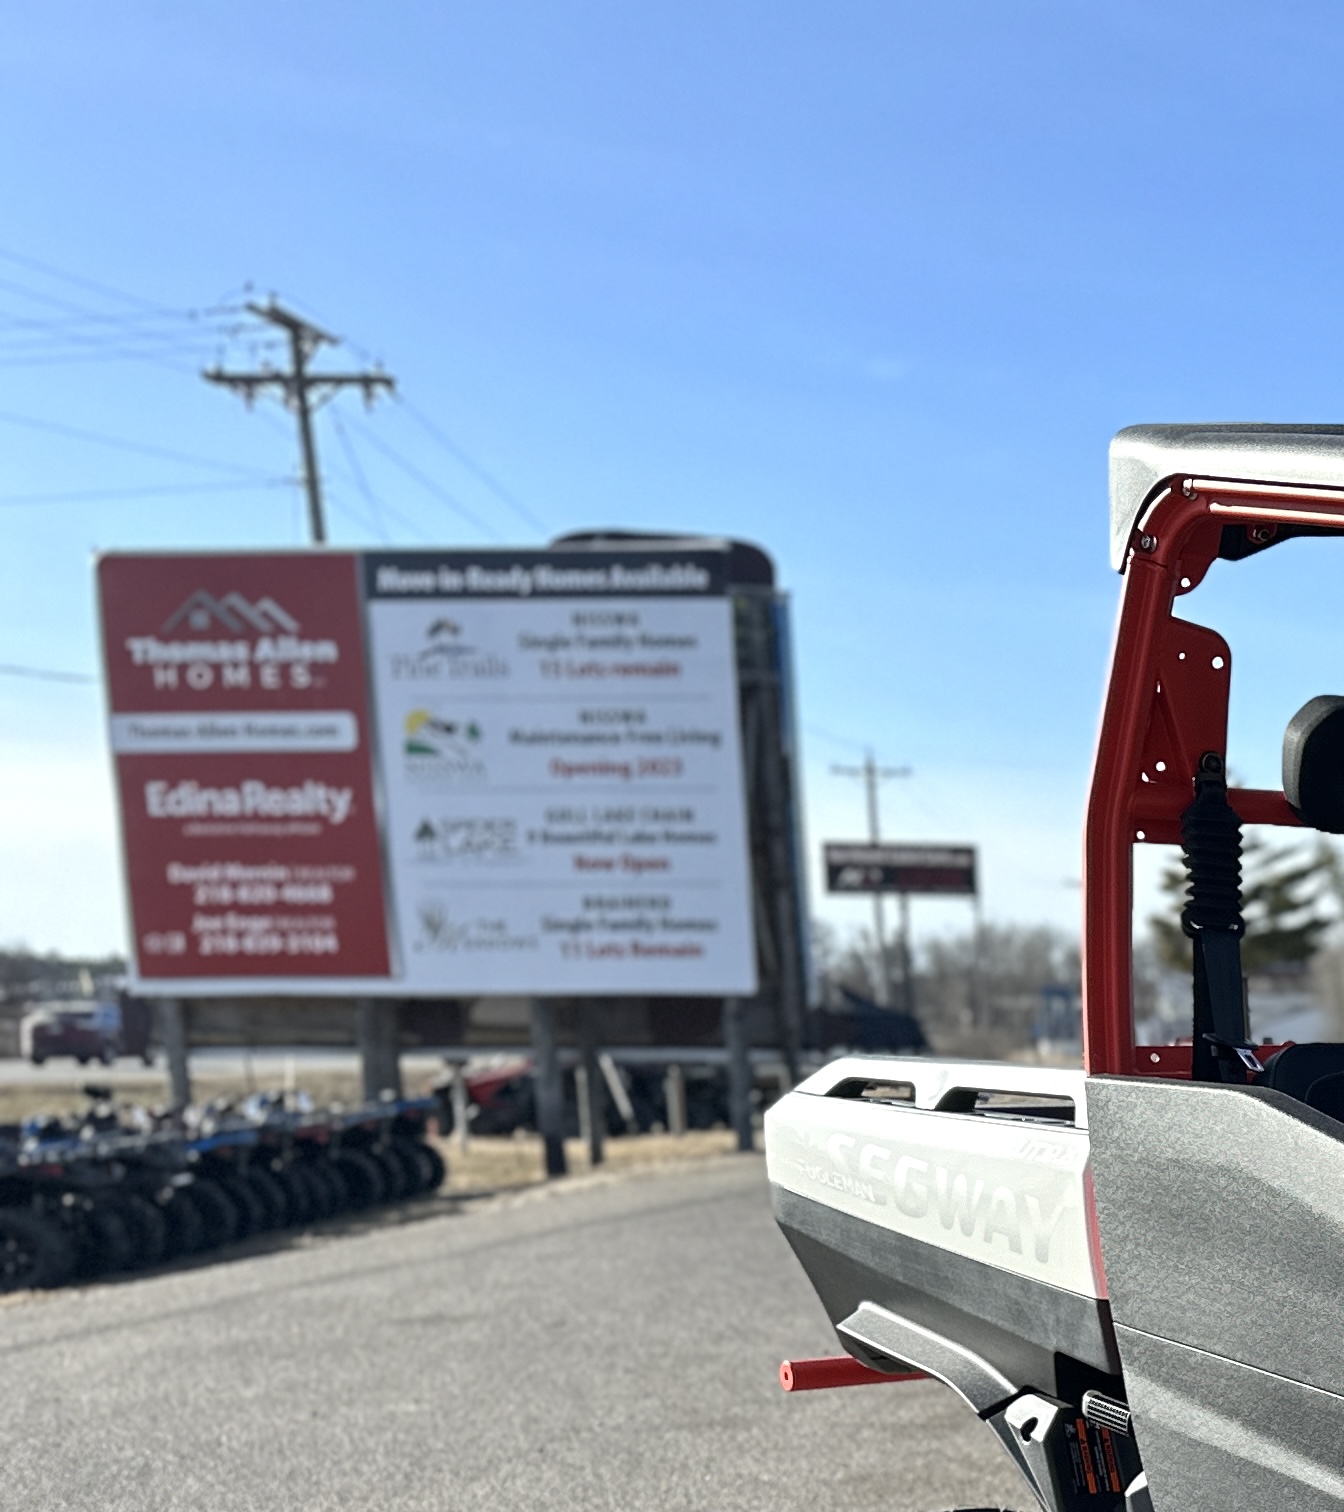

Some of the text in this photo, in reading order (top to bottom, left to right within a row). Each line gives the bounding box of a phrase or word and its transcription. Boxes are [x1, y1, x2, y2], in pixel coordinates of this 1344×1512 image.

[126, 635, 338, 664] Thomas Allen
[153, 664, 311, 689] HOMES
[826, 1133, 1064, 1264] SEGWAY
